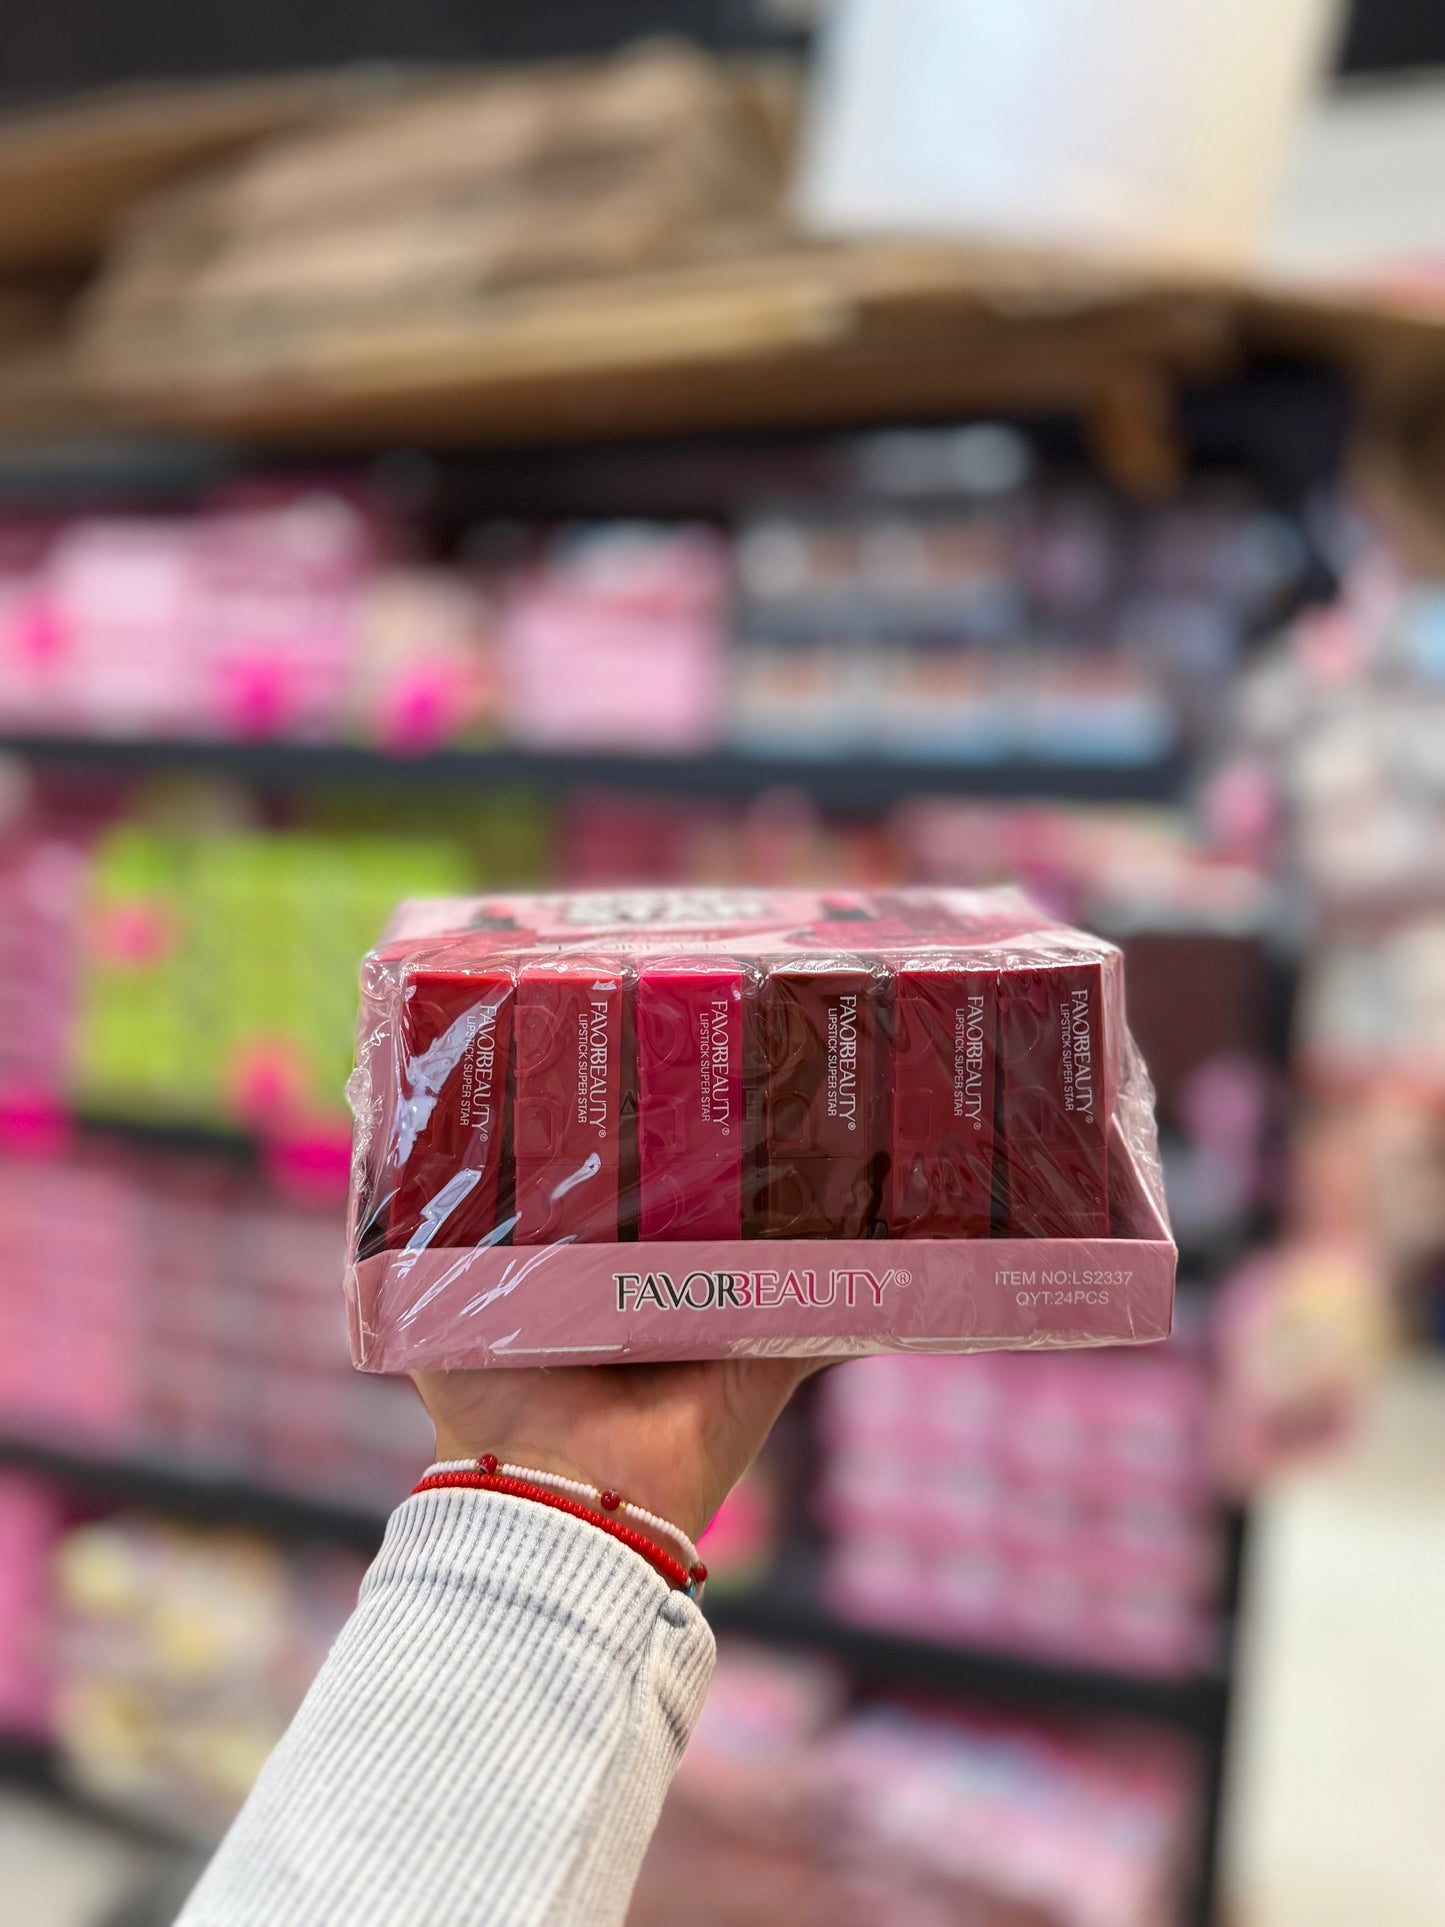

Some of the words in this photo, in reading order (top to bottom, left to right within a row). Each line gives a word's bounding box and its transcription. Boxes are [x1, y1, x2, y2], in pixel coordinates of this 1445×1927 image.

[464, 1015, 477, 1061] LIPSTICK
[577, 1013, 588, 1060] LIPSTICK
[699, 1012, 710, 1059] LIPSTICK
[827, 1007, 838, 1053] LIPSTICK
[954, 1008, 965, 1053] LIPSTICK
[1059, 1003, 1072, 1048] LIPSTICK
[461, 1063, 474, 1098] SUPER
[577, 1061, 588, 1096] SUPER
[700, 1060, 711, 1094] SUPER
[827, 1055, 837, 1089] SUPER
[954, 1055, 964, 1089] SUPER
[1061, 1050, 1073, 1084] SUPER
[459, 1099, 471, 1126] STAR
[577, 1098, 588, 1123] STAR
[701, 1096, 711, 1122] STAR
[827, 1091, 837, 1117] STAR
[953, 1091, 963, 1116] STAR
[1063, 1085, 1074, 1111] STAR
[994, 1270, 1036, 1285] ITEM
[1041, 1270, 1133, 1285] NO:LS2337
[1015, 1291, 1110, 1306] QYT:24PCS
